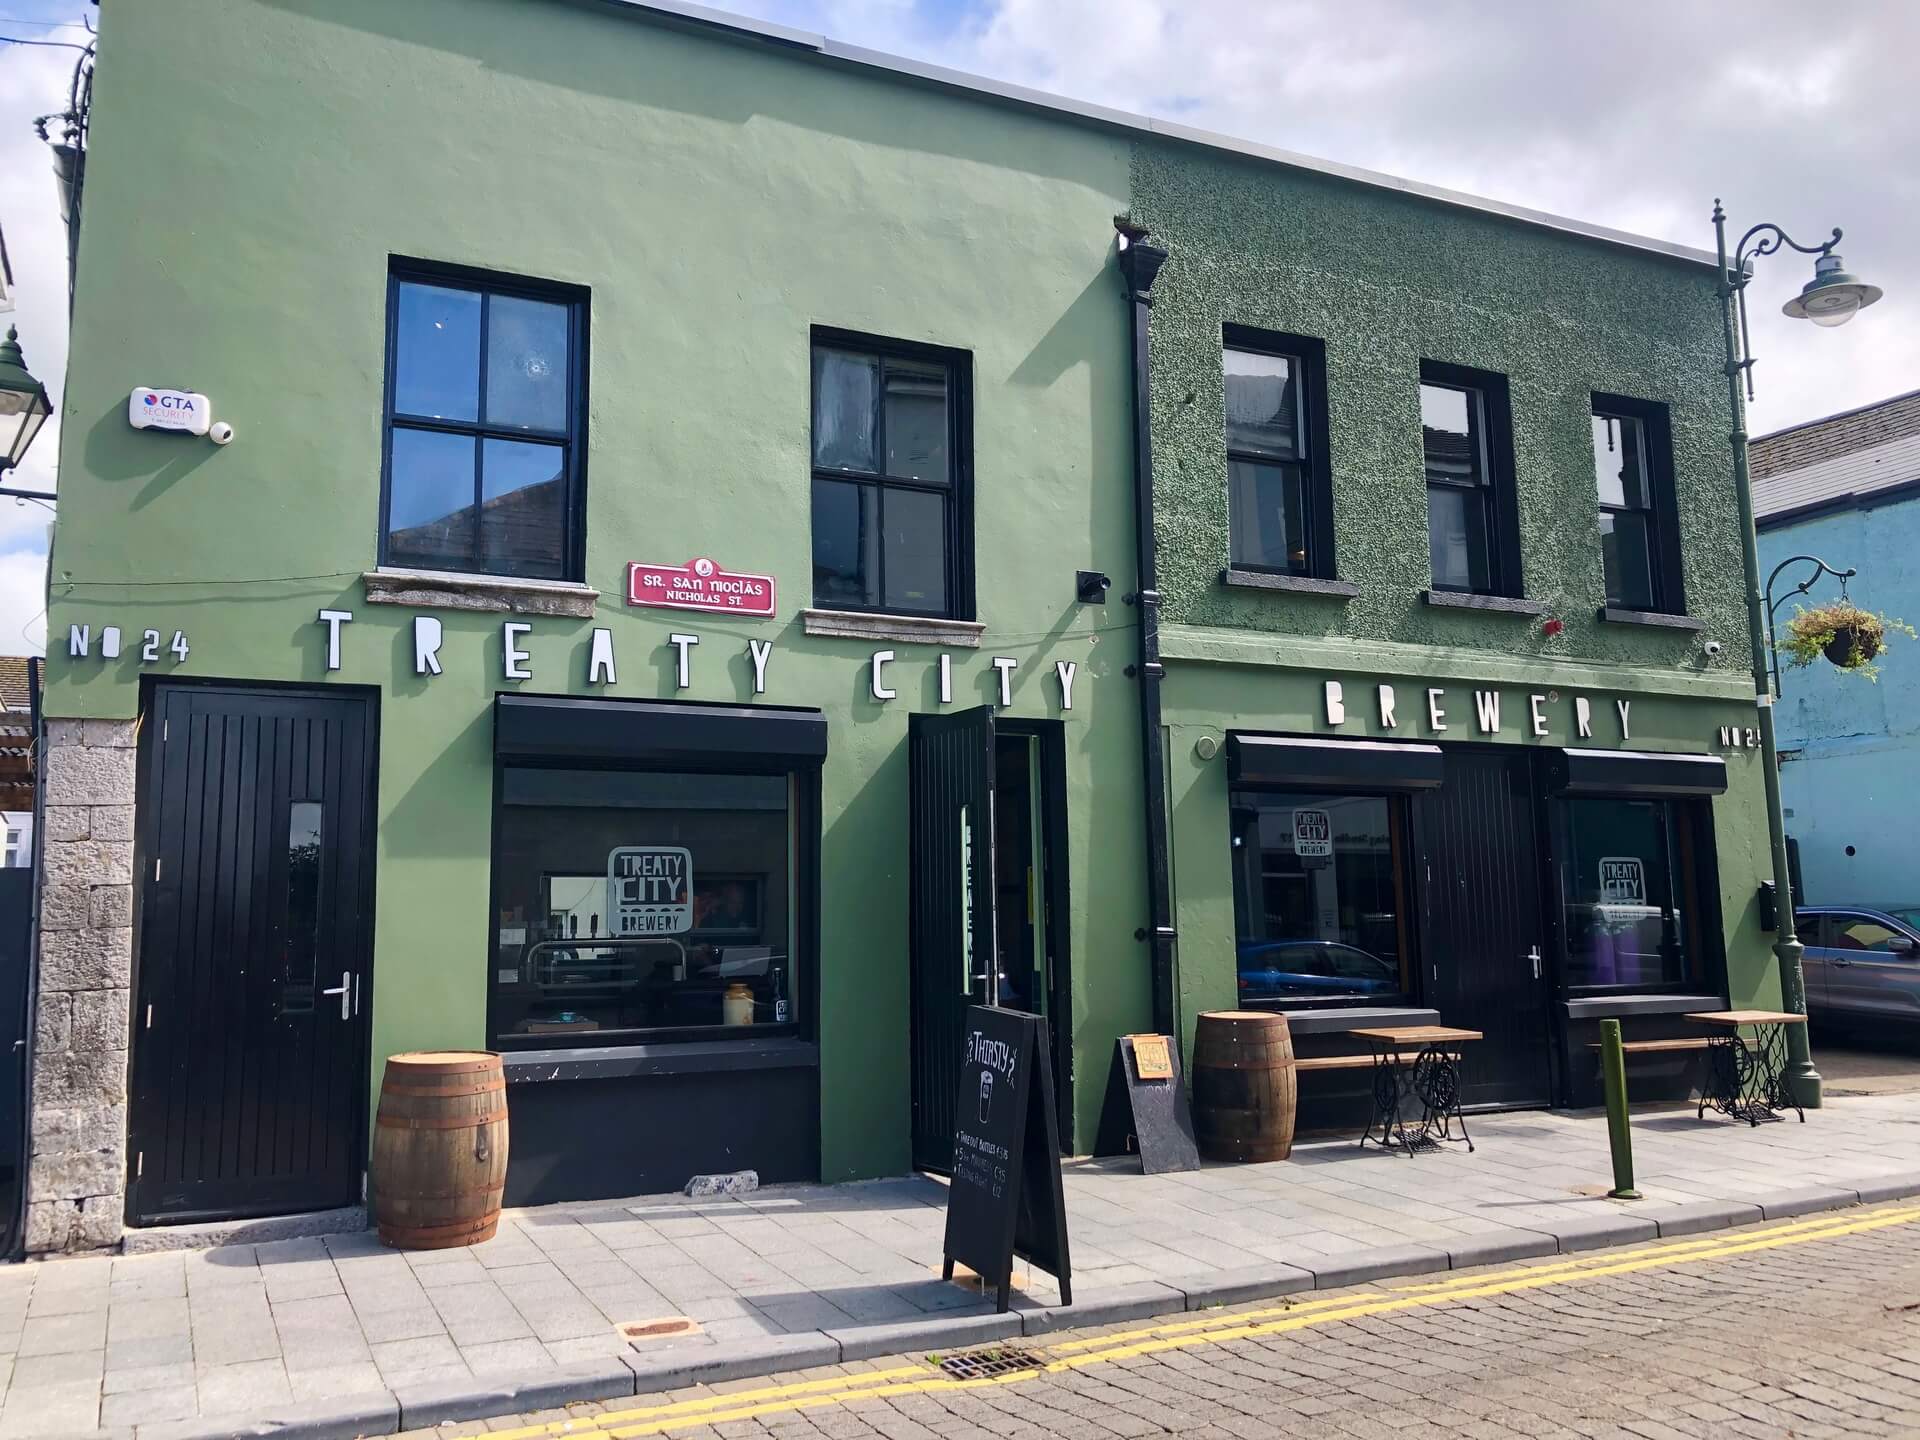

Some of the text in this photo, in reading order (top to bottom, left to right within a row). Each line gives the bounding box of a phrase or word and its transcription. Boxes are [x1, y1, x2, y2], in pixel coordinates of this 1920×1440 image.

[161, 396, 195, 411] GTA
[143, 406, 194, 420] SECURITY
[665, 590, 744, 606] NICHOLAS ST.
[69, 623, 191, 663] NO 24
[319, 609, 1077, 711] TREATY CITY
[1325, 681, 1632, 740] BREWERY
[1298, 825, 1326, 839] CITY
[620, 855, 682, 876] TREATY
[1604, 863, 1638, 879] TREATY
[619, 876, 682, 902] CITY
[1606, 879, 1639, 897] CITY
[621, 915, 680, 932] BREWERY
